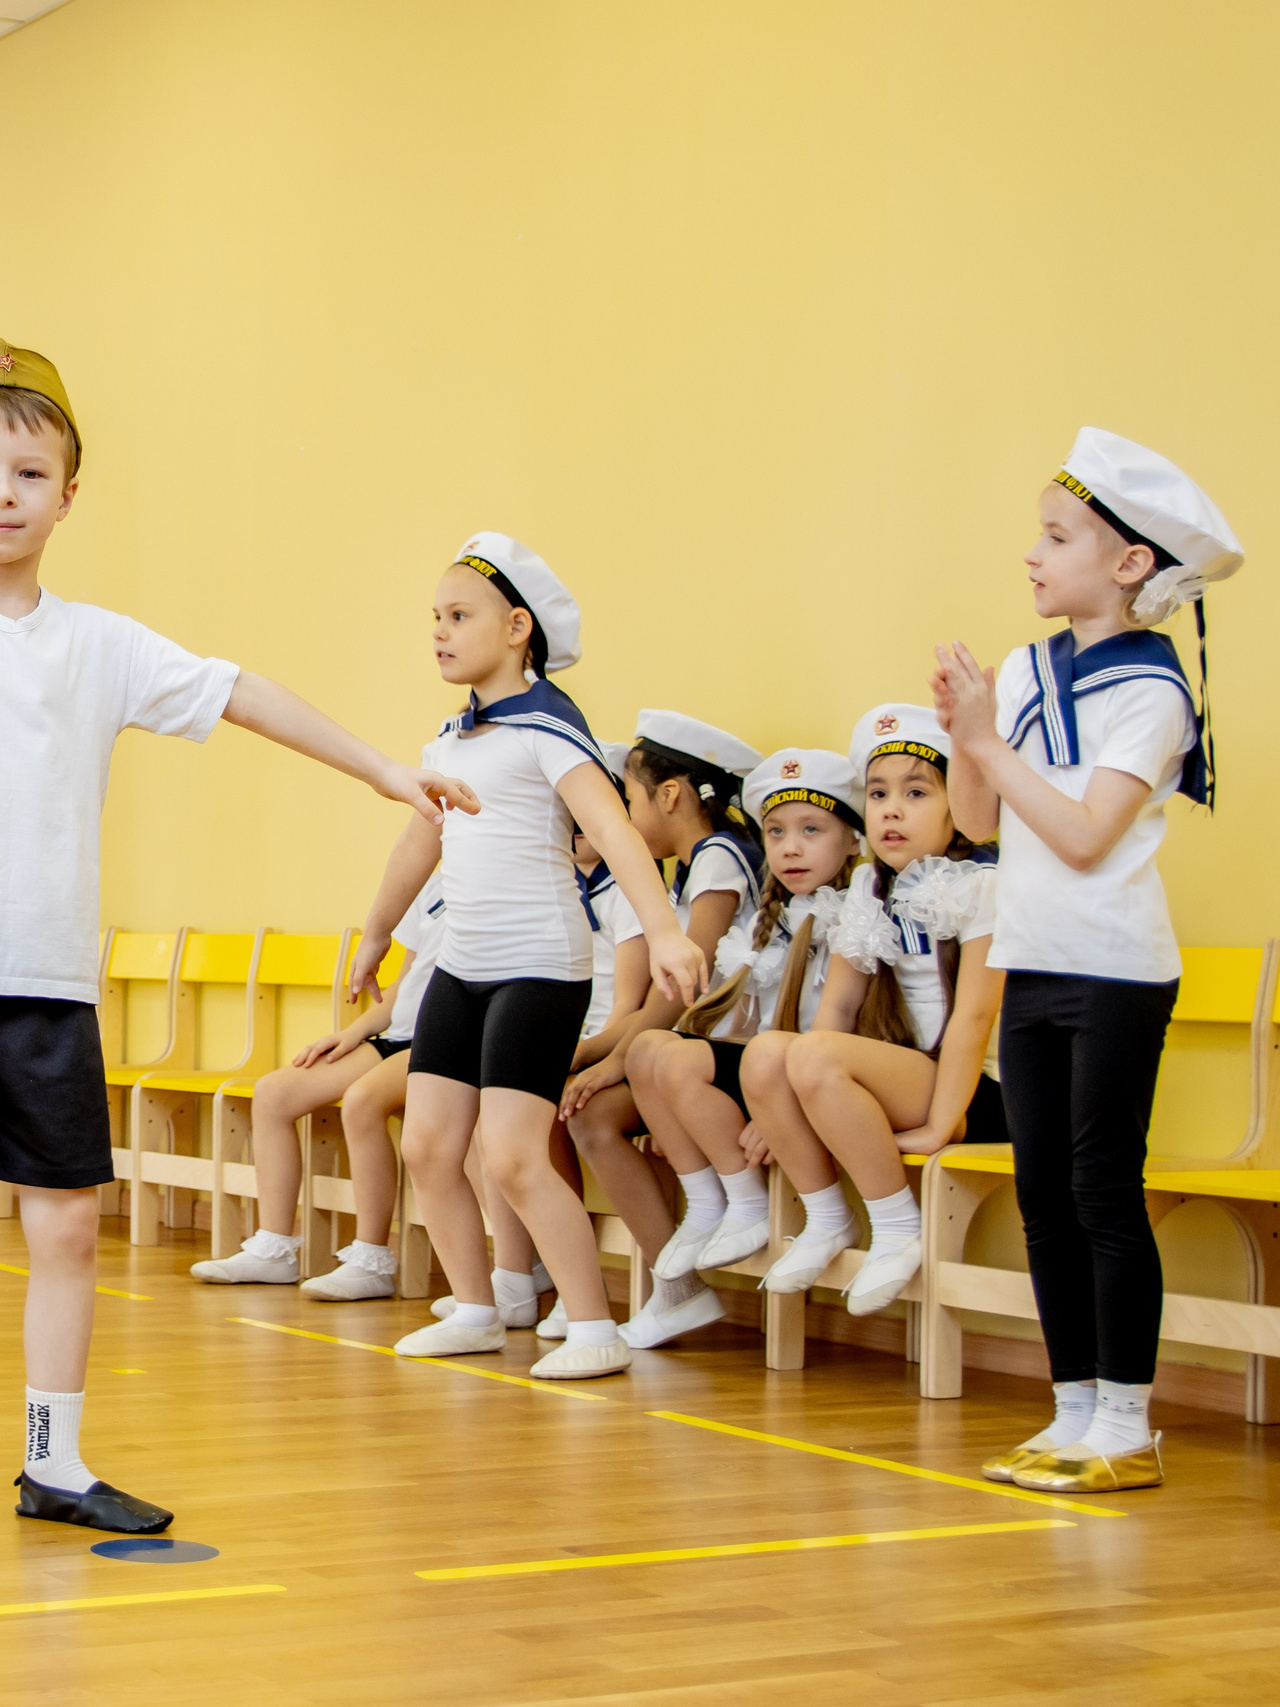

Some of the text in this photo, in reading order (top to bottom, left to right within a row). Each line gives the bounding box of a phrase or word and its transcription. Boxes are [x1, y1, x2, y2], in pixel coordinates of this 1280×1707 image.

[906, 742, 939, 762] ФЛОТ
[809, 792, 837, 812] ФЛОТ
[34, 1403, 51, 1461] ХОРОШИЙ
